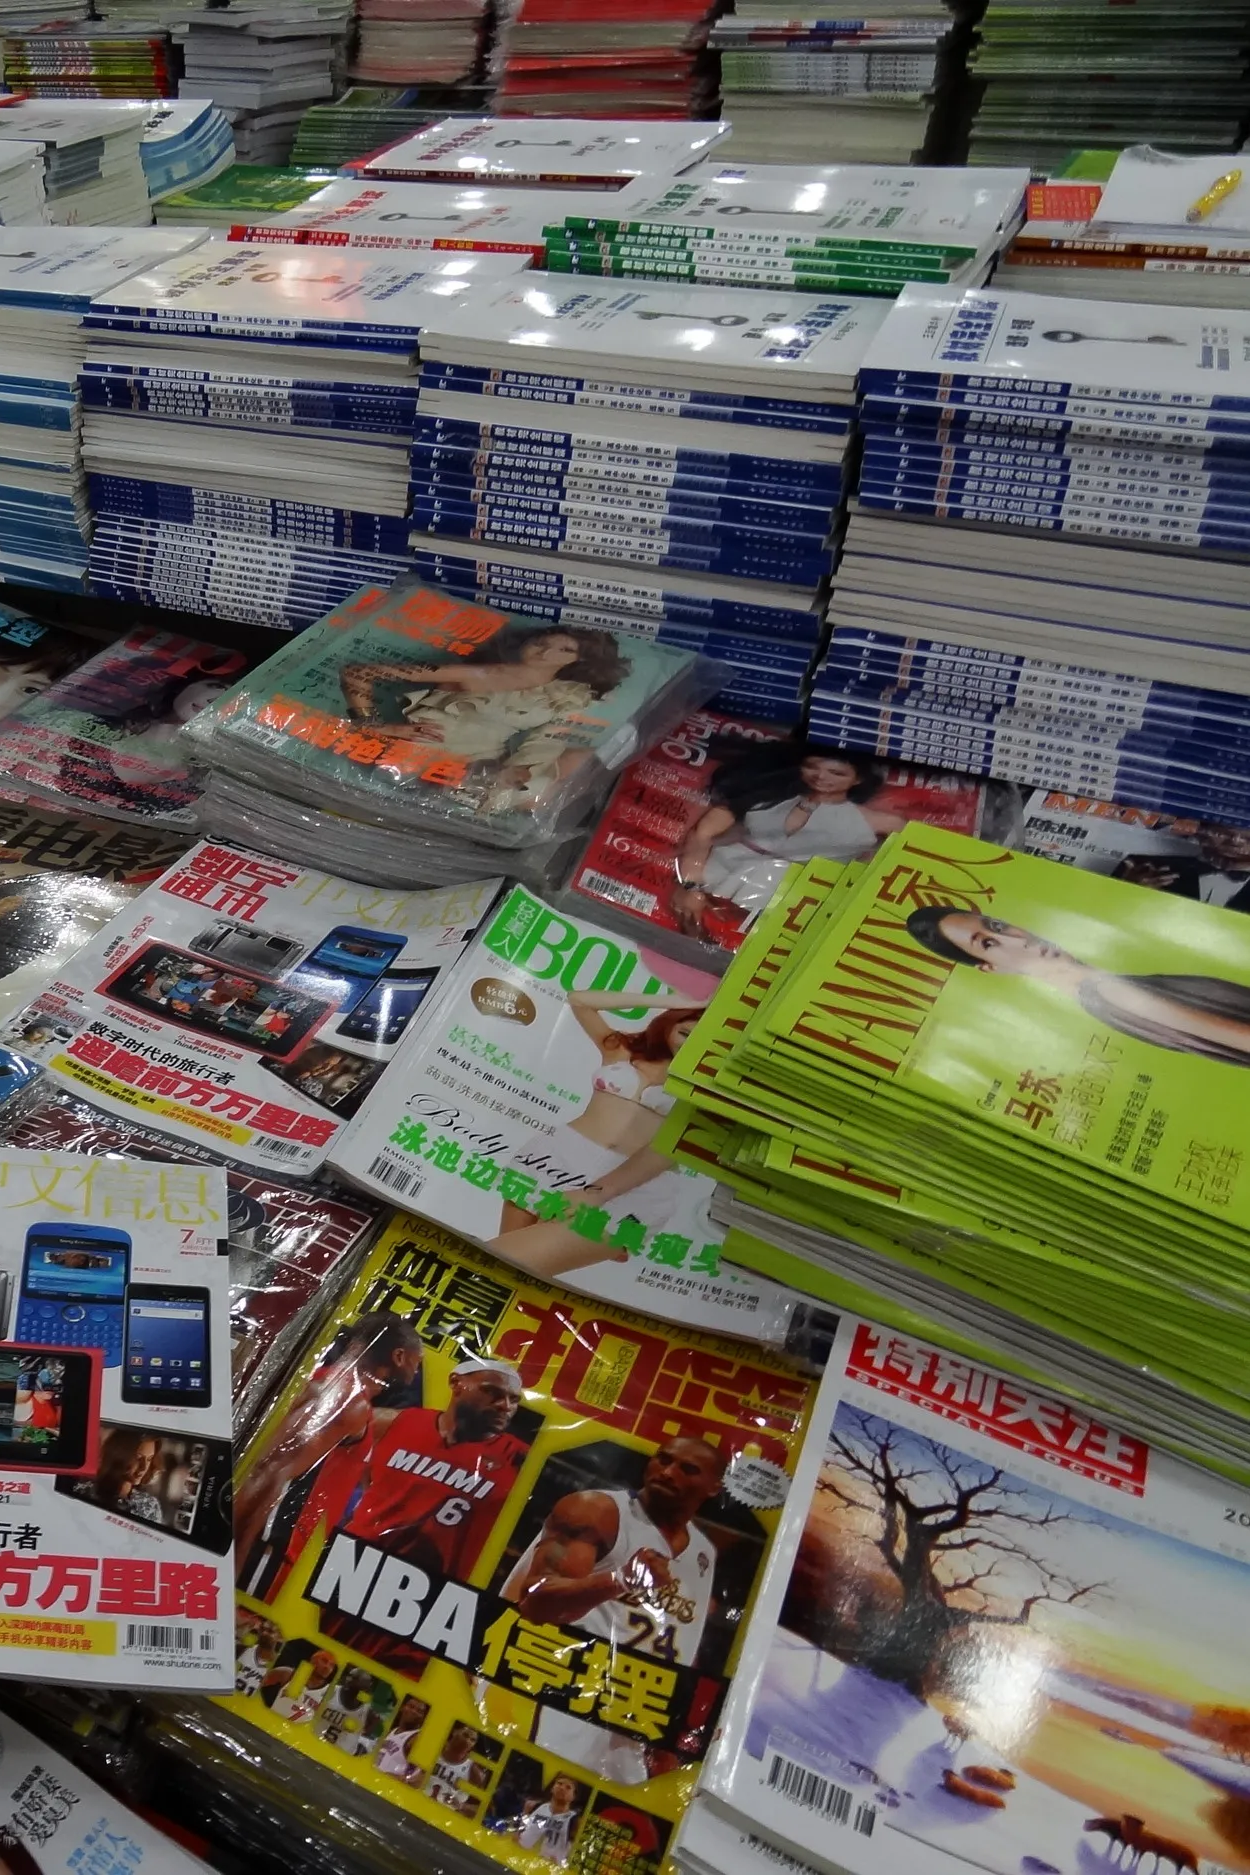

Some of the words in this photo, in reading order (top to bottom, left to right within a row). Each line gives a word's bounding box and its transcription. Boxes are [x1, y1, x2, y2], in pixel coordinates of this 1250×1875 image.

[158, 868, 271, 923] 通讯
[189, 845, 299, 889] 数字
[85, 1019, 238, 1087] 数字时代的旅行者
[65, 1032, 340, 1149] 遥瞻前方万里路
[404, 1092, 508, 1158] Body
[512, 1148, 604, 1196] shape
[854, 1369, 992, 1447] SPECIAL
[1022, 1440, 1147, 1498] FOCUS
[864, 1327, 1137, 1475] 特别关注
[385, 1447, 497, 1501] MIAMI
[436, 1496, 472, 1528] 6
[310, 1538, 481, 1666] NBA
[626, 1611, 681, 1660] 24
